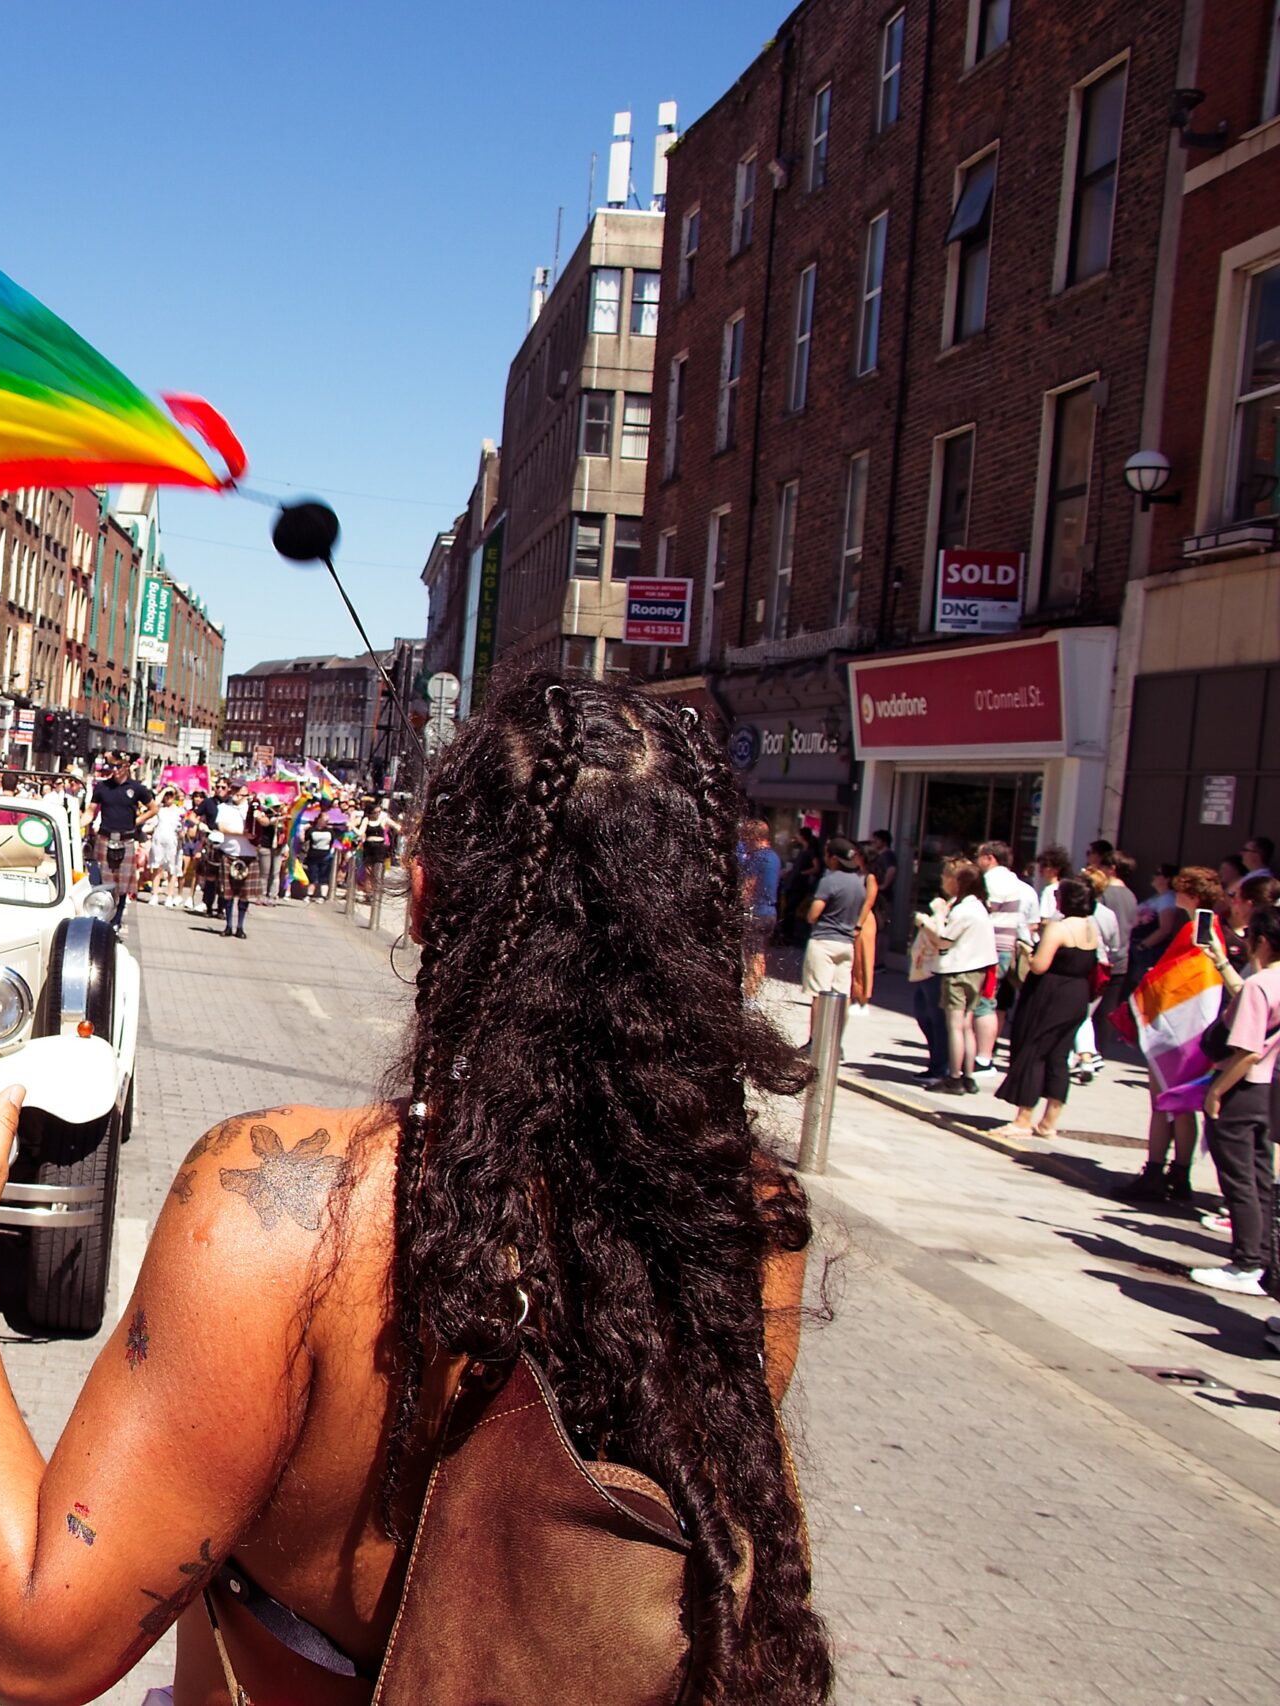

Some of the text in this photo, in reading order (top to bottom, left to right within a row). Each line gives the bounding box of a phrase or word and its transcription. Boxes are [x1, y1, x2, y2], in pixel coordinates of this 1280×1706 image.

[946, 563, 1016, 585] SOLD
[144, 581, 159, 633] Shopping
[480, 548, 497, 643] ENGLISH
[631, 604, 682, 619] Rooney
[942, 602, 978, 617] DNG
[643, 625, 681, 635] 413511
[876, 692, 927, 718] vodafone
[975, 685, 1044, 711] O'Connell St.
